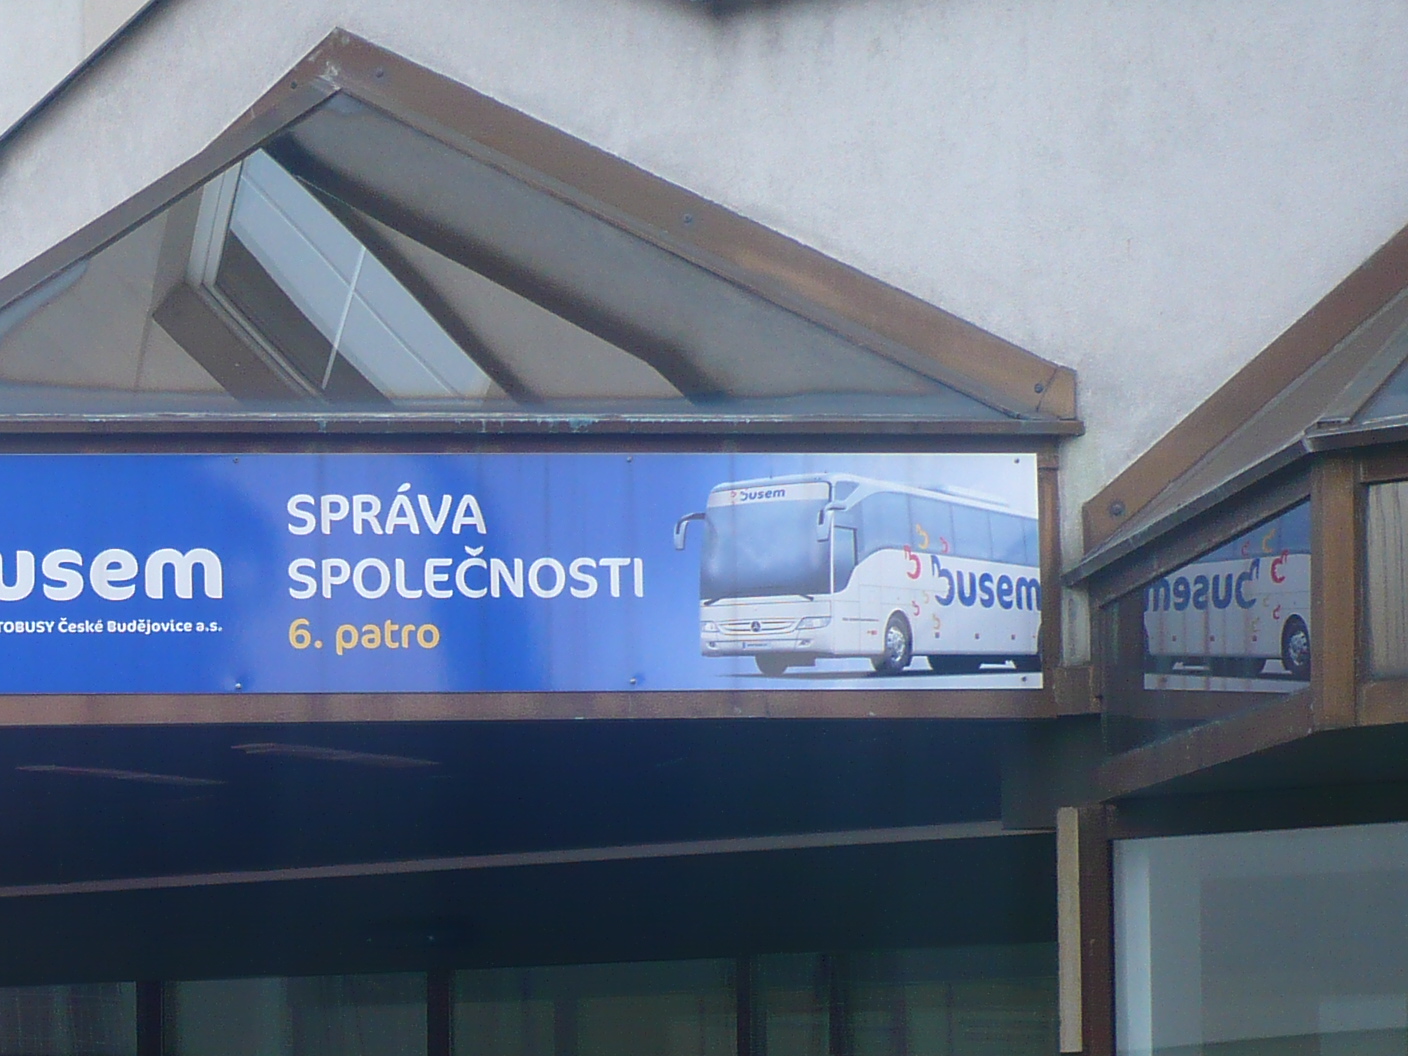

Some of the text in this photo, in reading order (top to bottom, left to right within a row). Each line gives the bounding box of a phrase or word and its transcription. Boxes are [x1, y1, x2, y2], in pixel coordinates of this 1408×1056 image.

[287, 482, 488, 535] SPRÁVA
[287, 545, 645, 600] SPOLEČNOSTI
[57, 616, 104, 635] České
[106, 618, 193, 636] Budějovice
[195, 621, 224, 634] a.s.
[288, 617, 441, 656] 6. patro
